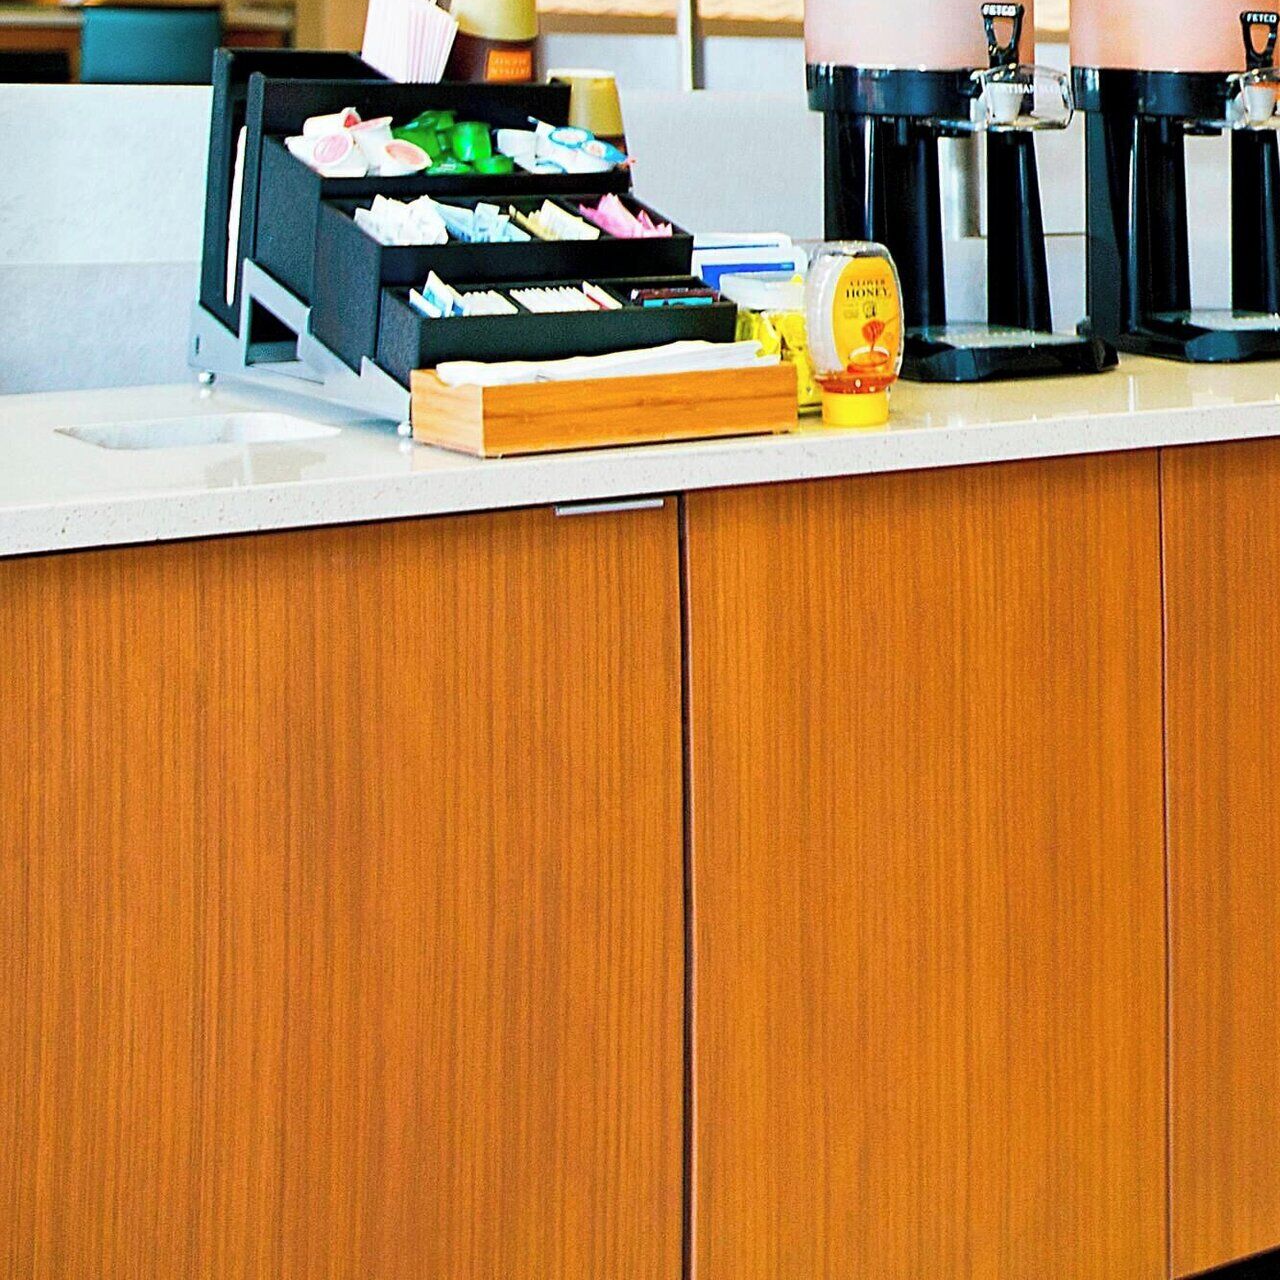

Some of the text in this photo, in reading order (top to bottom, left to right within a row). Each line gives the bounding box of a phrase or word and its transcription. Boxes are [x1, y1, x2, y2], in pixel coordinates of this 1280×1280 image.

[983, 4, 1017, 17] FETCO
[1246, 13, 1278, 23] FETCO
[850, 278, 886, 287] CLOVER
[845, 287, 889, 299] HONEY
